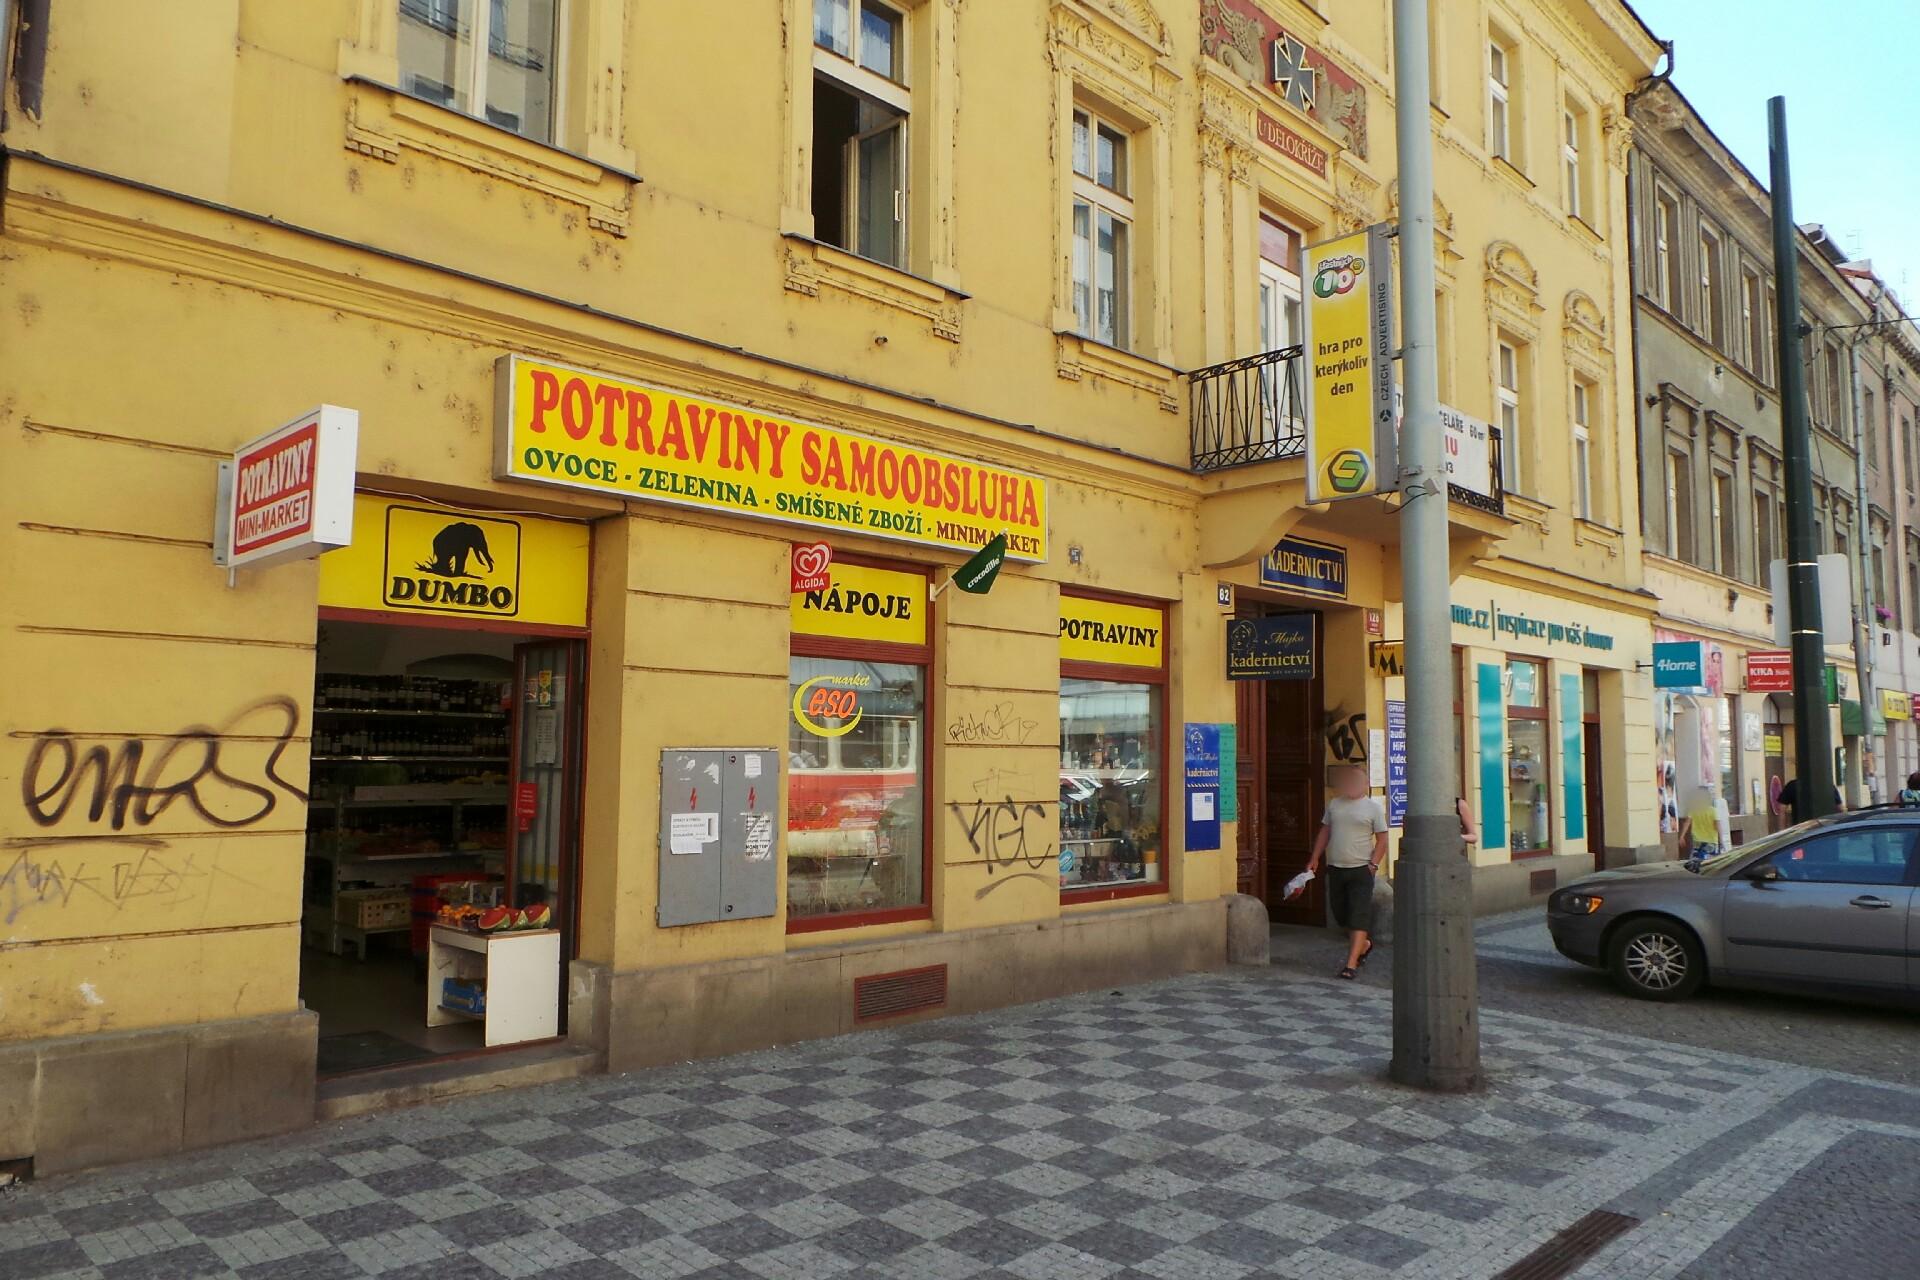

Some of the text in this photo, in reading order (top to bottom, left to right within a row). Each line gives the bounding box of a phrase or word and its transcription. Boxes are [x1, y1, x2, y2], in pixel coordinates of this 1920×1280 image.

[1319, 337, 1363, 356] hra pro
[1378, 282, 1389, 400] CZECH ADVERTISING
[1315, 355, 1368, 378] kterýkoliv
[1331, 382, 1354, 396] den
[530, 369, 1040, 528] POTRAVINY SAMOOBSLUHA
[240, 438, 313, 508] POTRAVINY
[524, 447, 618, 483] OVOCE
[639, 467, 759, 508] ZELENINA
[775, 491, 864, 525] SMÍŠENÉ
[868, 508, 923, 535] ZBOŽÍ
[239, 495, 308, 540] MINI-MARKET
[1268, 549, 1343, 584] KADEŘNICTVÍ
[390, 576, 514, 609] DUMBO
[794, 576, 825, 591] ALGIDA
[803, 583, 911, 620] NÁPOJE
[1059, 617, 1159, 648] POTRAVINY
[1547, 622, 1564, 646] pro
[1565, 621, 1582, 645] váš
[1230, 649, 1311, 668] kadeřnictví
[1750, 667, 1774, 676] KIKA
[831, 672, 870, 687] market
[808, 687, 857, 718] eso
